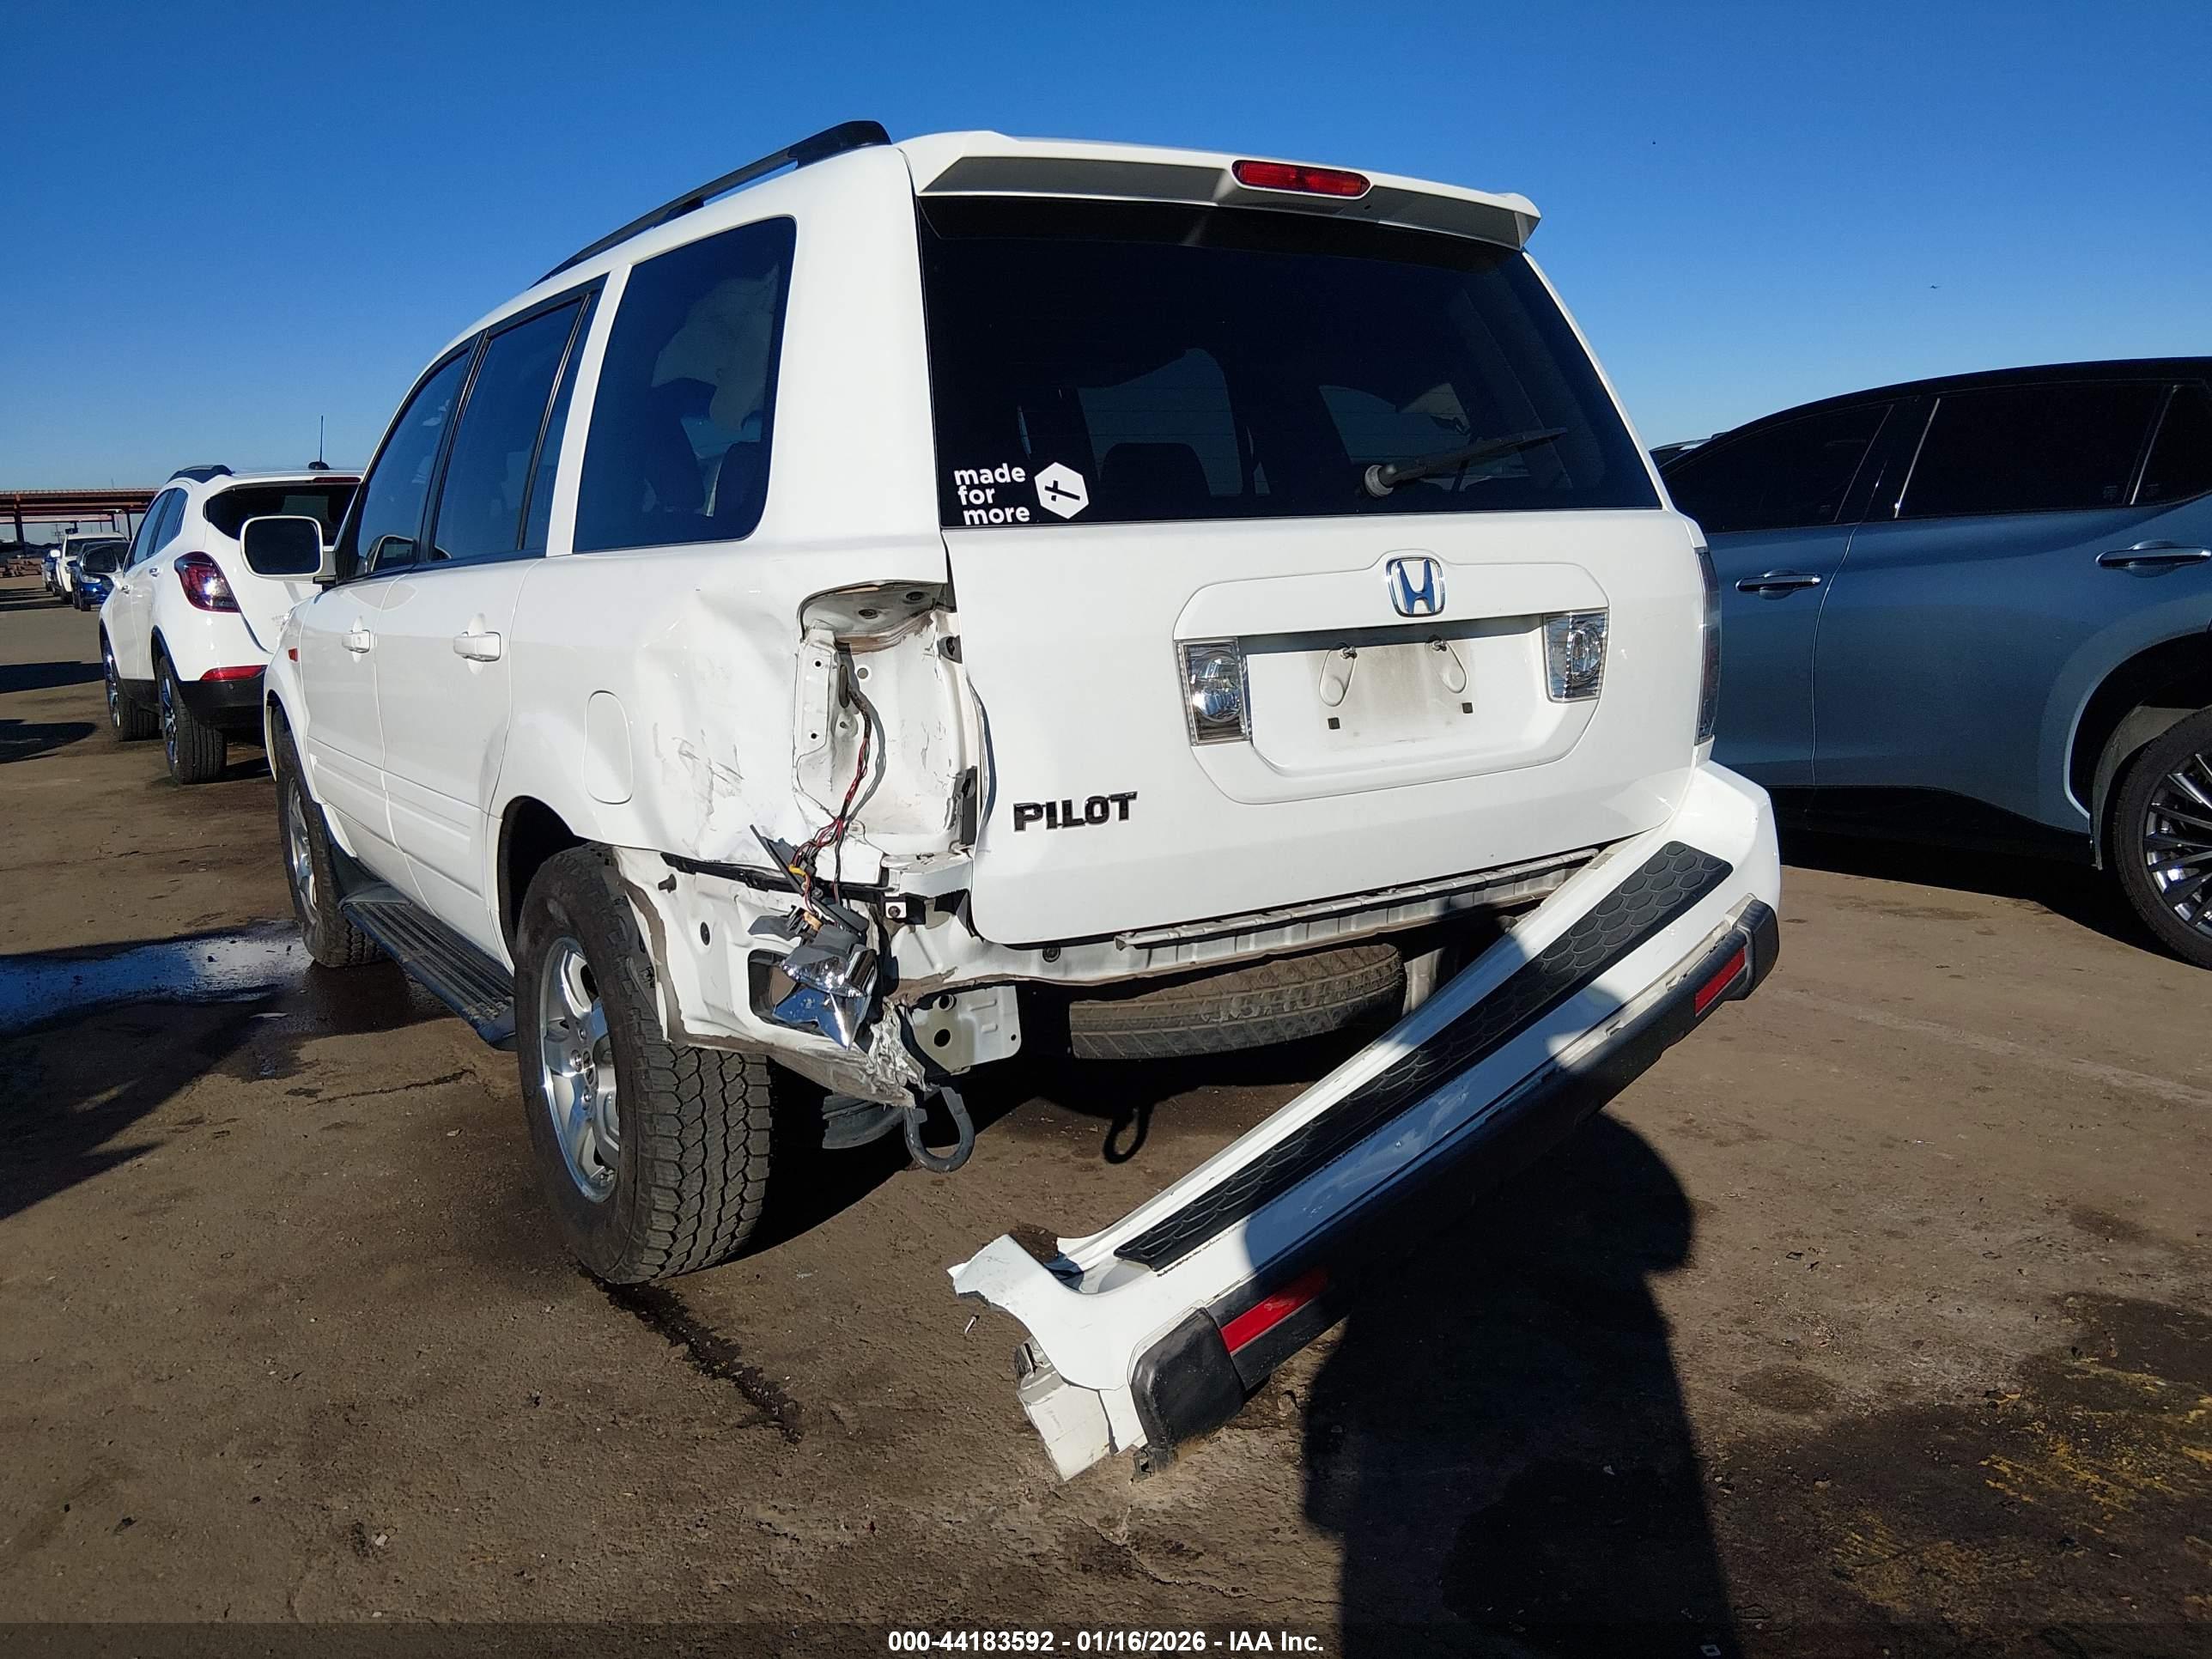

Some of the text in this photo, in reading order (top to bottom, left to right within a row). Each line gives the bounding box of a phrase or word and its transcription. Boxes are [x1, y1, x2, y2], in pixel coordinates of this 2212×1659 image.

[954, 463, 1026, 486] made
[957, 485, 995, 506] for
[963, 506, 1030, 526] more
[1013, 791, 1138, 832] PILOT
